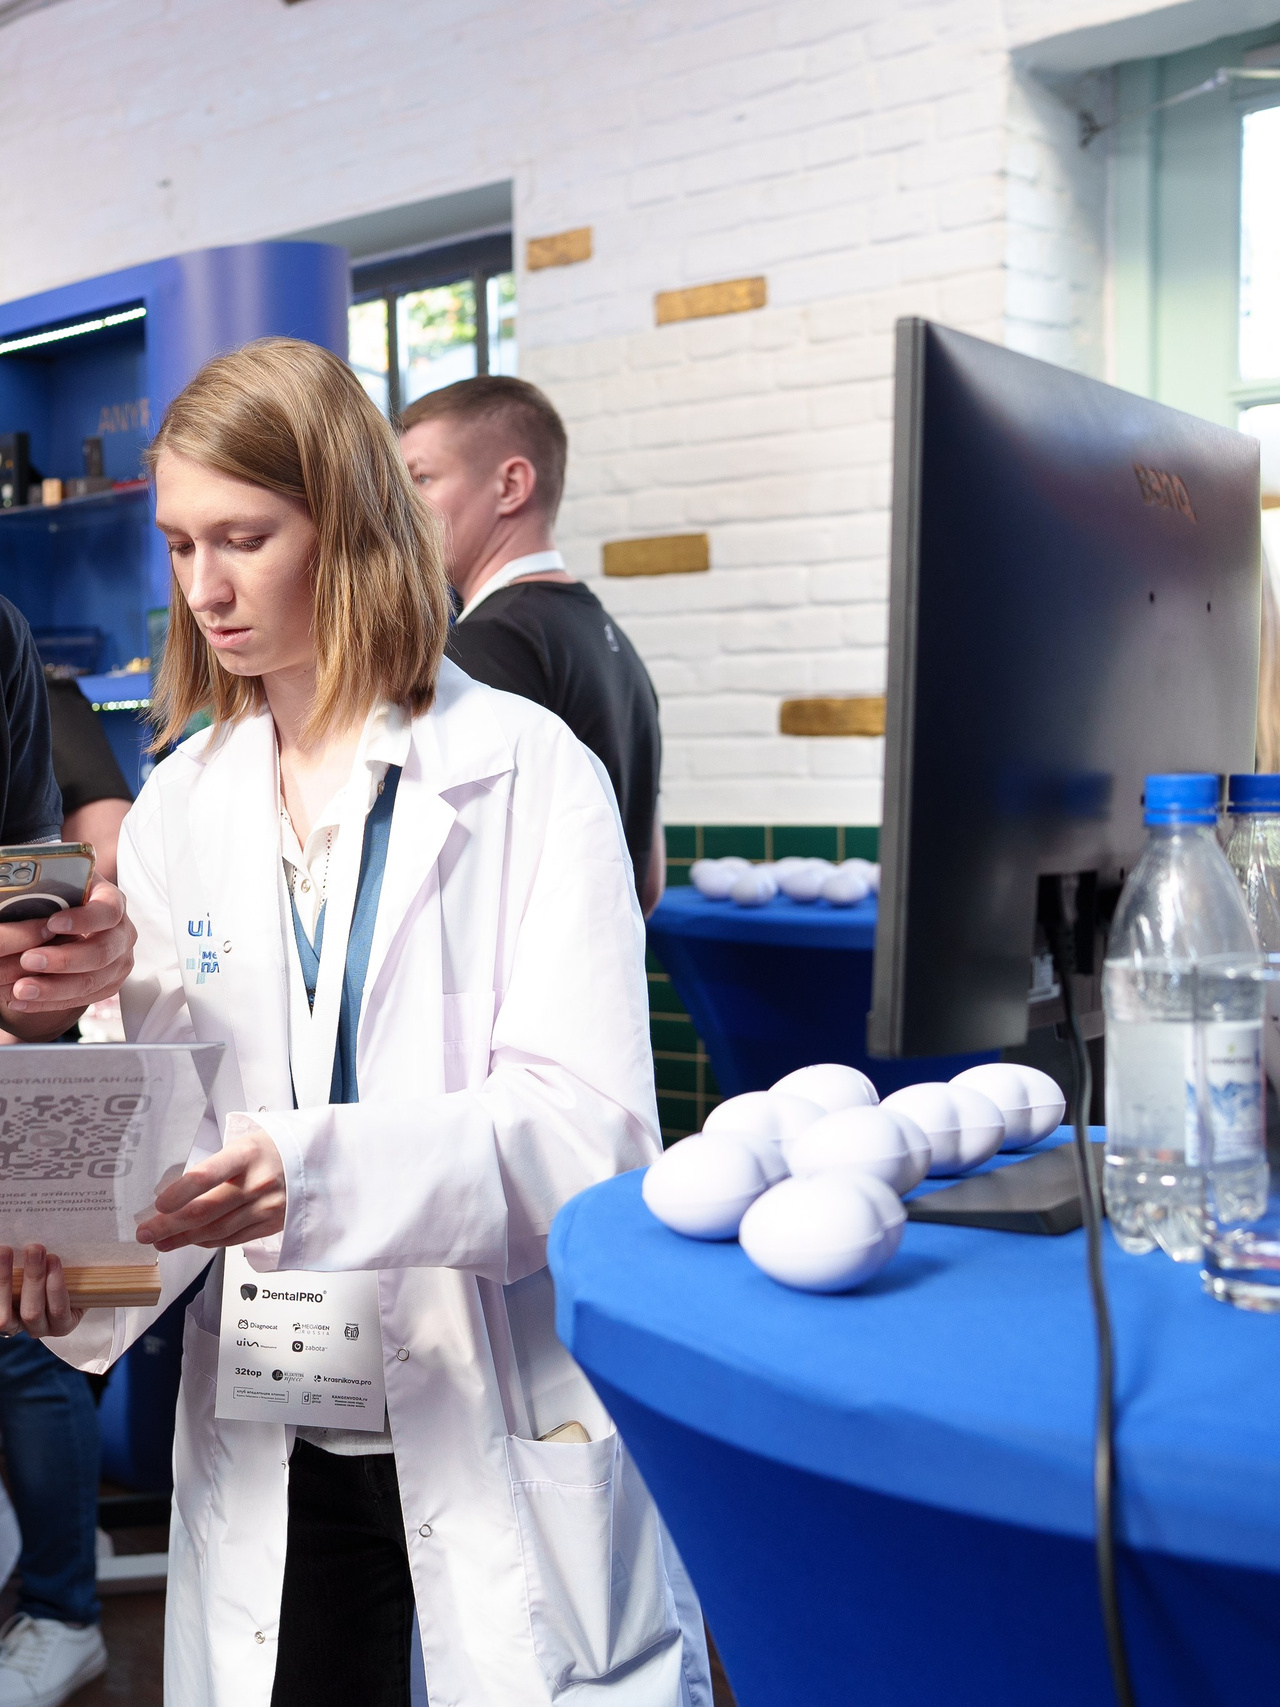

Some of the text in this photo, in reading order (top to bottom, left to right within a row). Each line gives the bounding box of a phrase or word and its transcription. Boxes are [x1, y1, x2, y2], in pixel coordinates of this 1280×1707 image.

[250, 1322, 278, 1330] Diagnocat
[235, 1367, 262, 1378] 32top
[323, 1376, 372, 1386] krasnikova.pro
